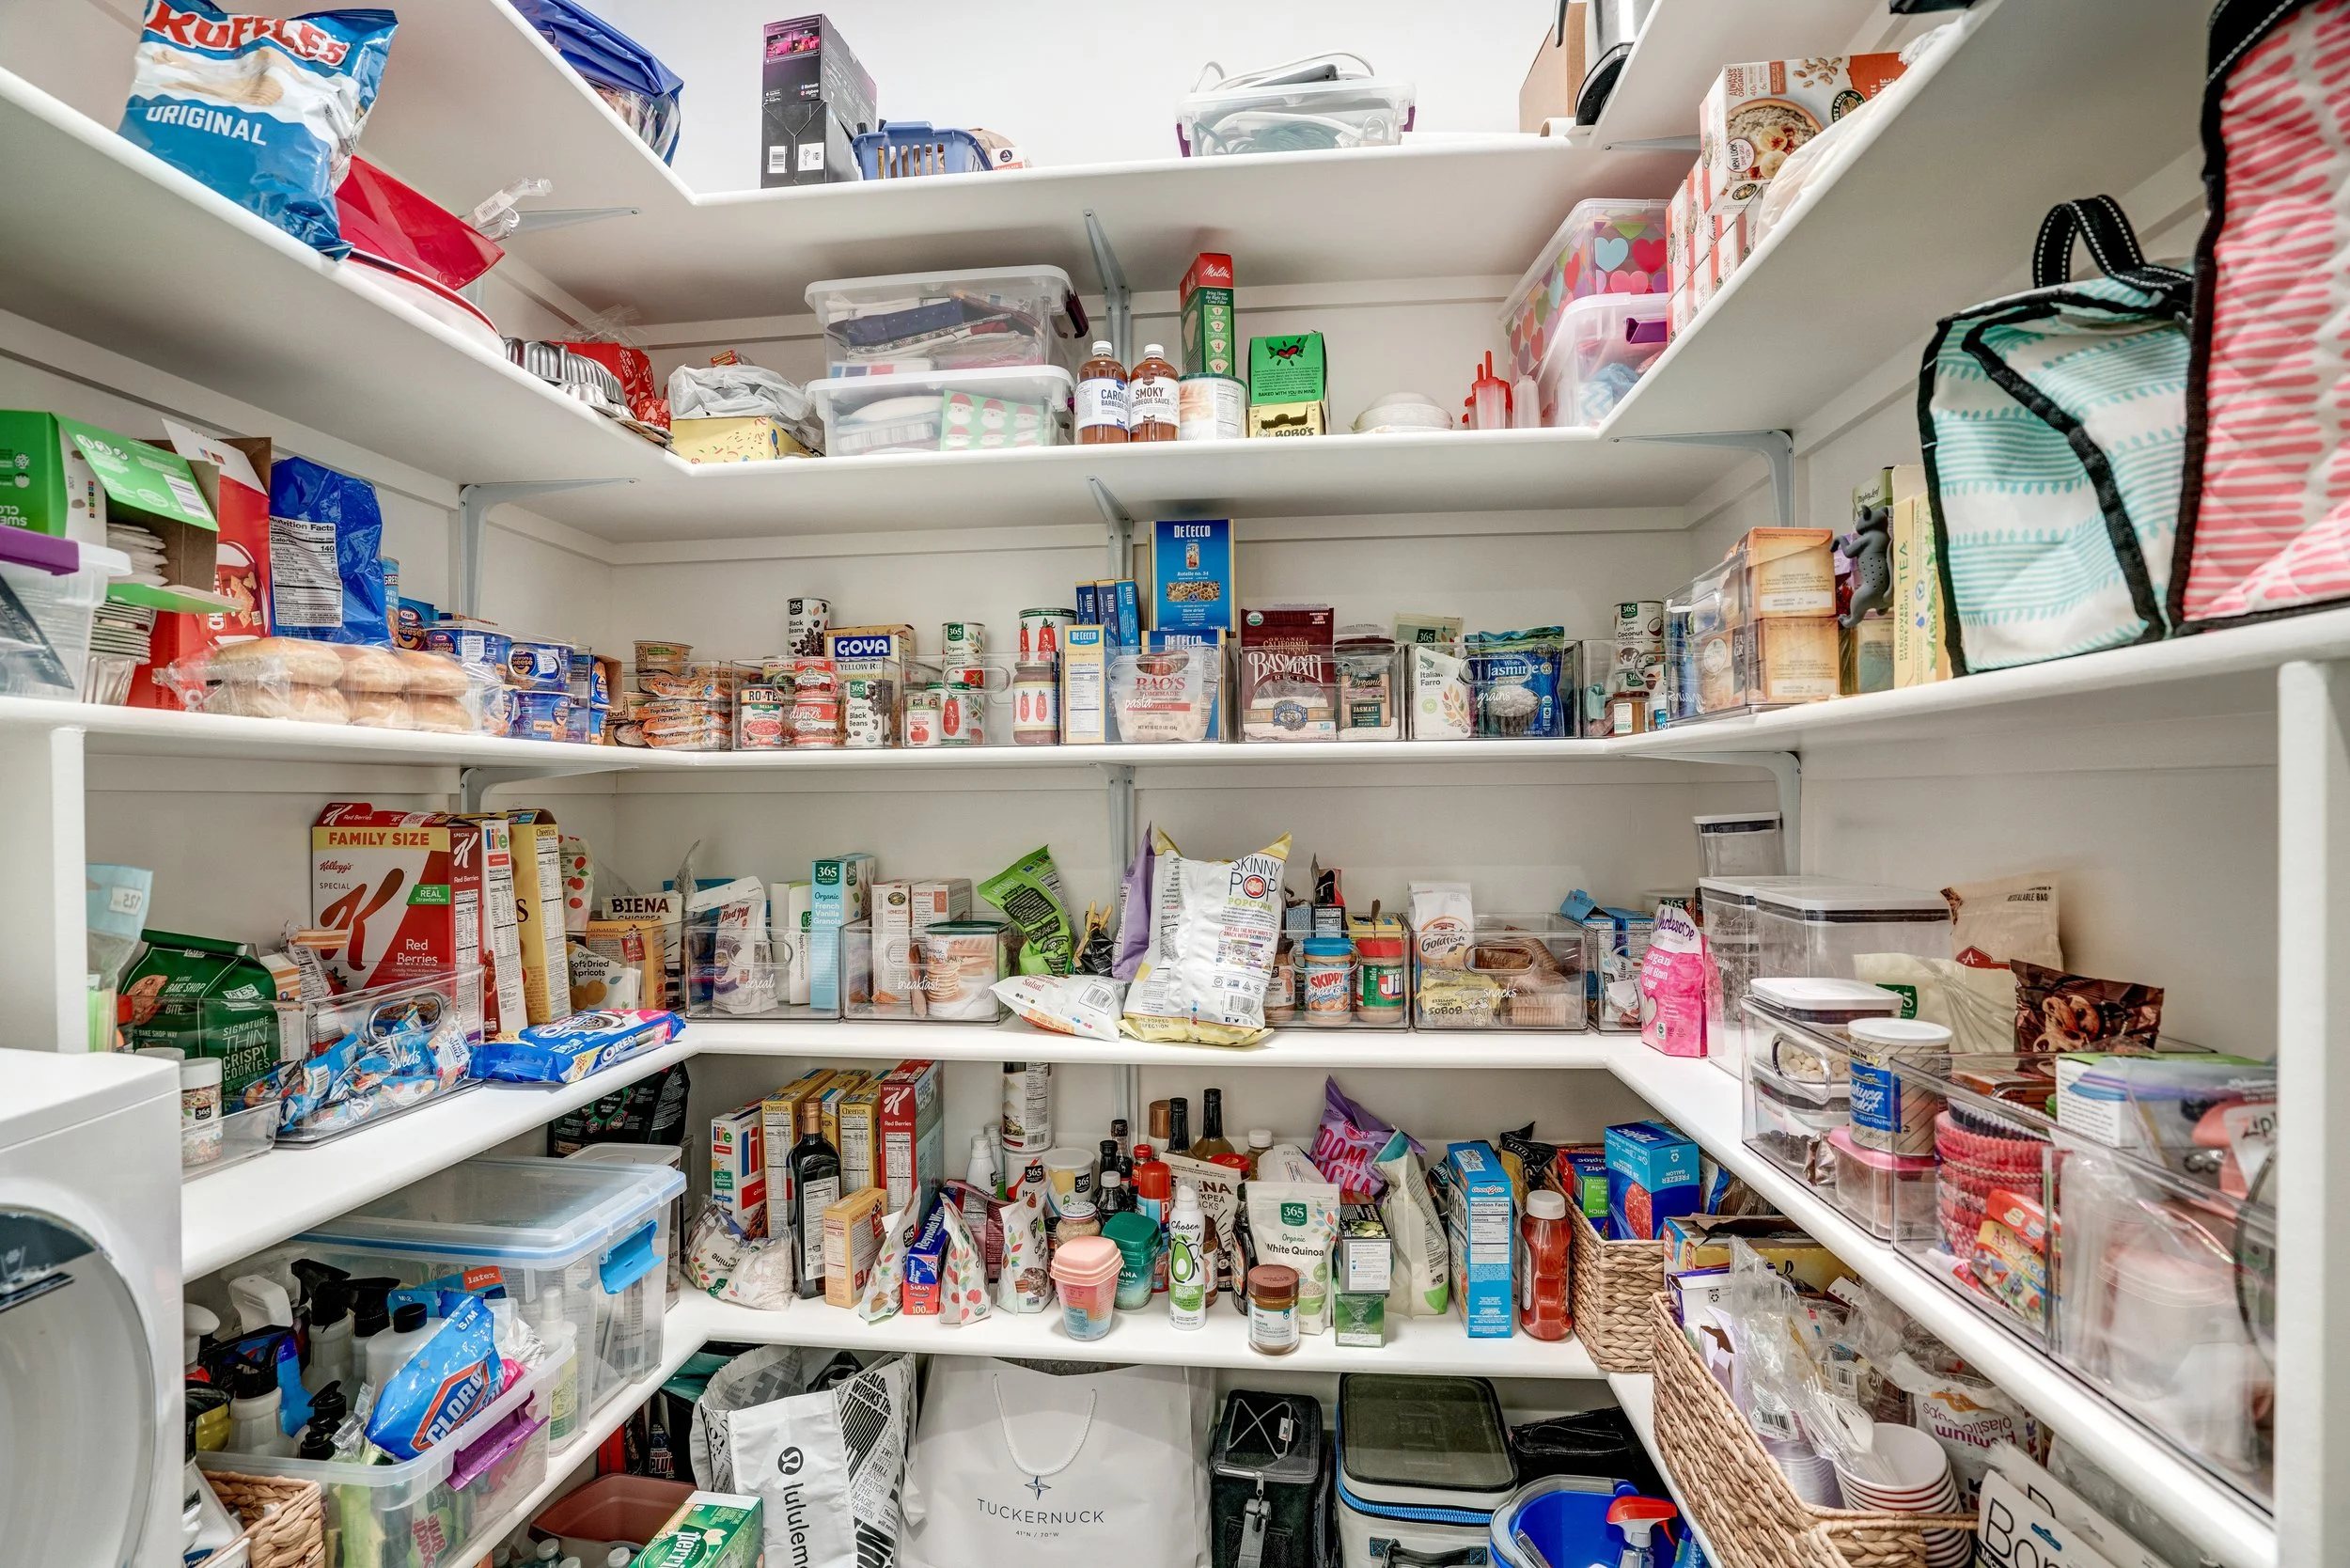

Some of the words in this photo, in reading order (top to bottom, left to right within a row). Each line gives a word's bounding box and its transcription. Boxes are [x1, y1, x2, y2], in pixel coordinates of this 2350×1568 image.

[1728, 68, 1738, 97] ALWAYS
[146, 104, 267, 146] ORIGINAL
[1202, 263, 1230, 279] Melitta
[1136, 387, 1164, 400] SMOKY
[1132, 399, 1153, 408] BARBEQUE
[1154, 398, 1171, 406] SAUCE
[1857, 490, 1872, 503] Mighty
[310, 524, 335, 532] Facts
[1185, 525, 1211, 538] CECCO
[1899, 541, 1908, 585] TEA
[790, 602, 801, 610] 365
[1622, 604, 1637, 613] 365
[401, 610, 416, 620] Kraft
[948, 627, 963, 636] 365
[1080, 631, 1096, 640] CECCO
[1418, 632, 1434, 643] 365
[837, 638, 888, 656] GOYA
[839, 662, 868, 671] YELLOW
[1248, 652, 1324, 686] BASMATI
[1487, 664, 1539, 677] Jasmine
[852, 683, 864, 693] 365
[1136, 677, 1186, 691] RAO'S
[1125, 694, 1153, 713] pasta
[1477, 691, 1512, 708] grains
[790, 705, 822, 722] dinner
[329, 832, 386, 846] FAMILY
[392, 832, 430, 846] SIZE
[486, 828, 509, 851] life
[536, 828, 556, 838] Cheerios
[320, 860, 352, 873] Kellogg's
[818, 866, 838, 878] 365
[1231, 855, 1280, 875] SKINNY
[420, 889, 442, 898] REAL
[1229, 871, 1277, 902] POP
[814, 892, 839, 902] Organic
[2036, 892, 2049, 902] BAG
[611, 898, 669, 914] BIENA
[1227, 897, 1274, 913] POPCORN
[320, 868, 405, 971] K
[405, 939, 429, 950] Red
[1249, 934, 1272, 943] SKINNYPOP
[1421, 935, 1466, 952] Goldfish
[397, 952, 438, 966] Berries
[588, 960, 610, 968] Dried
[572, 969, 606, 979] Apricots
[744, 973, 776, 989] cereal
[1309, 972, 1344, 989] SKIPPY
[165, 982, 184, 994] BAKE
[186, 982, 207, 994] SHOP
[897, 975, 941, 991] breakfast
[1022, 979, 1045, 992] Salsa!
[1482, 982, 1517, 998] snacks
[225, 984, 256, 998] TATE'S
[164, 1004, 185, 1016] BITE.
[223, 1015, 269, 1037] SIGNATURE
[222, 1027, 268, 1055] THIN
[600, 1035, 634, 1062] OREO
[223, 1044, 268, 1071] CRISPY
[389, 1047, 421, 1073] sweets
[224, 1058, 271, 1081] COOKIES
[917, 1081, 931, 1099] FREE
[764, 1104, 789, 1113] Cheerios
[884, 1088, 911, 1116] K
[196, 1108, 212, 1117] 365
[841, 1106, 866, 1116] Cheerios
[713, 1126, 732, 1143] life
[1026, 1168, 1042, 1178] 365
[1612, 1160, 1633, 1176] FREEZER
[1076, 1177, 1089, 1188] 365
[1661, 1174, 1690, 1184] FREEZER
[1284, 1206, 1304, 1218] 365
[1171, 1220, 1200, 1231] Chosen
[903, 1226, 915, 1240] 365
[917, 1219, 940, 1250] Reynolds
[1281, 1233, 1307, 1244] Organic
[1265, 1242, 1290, 1254] White
[1292, 1247, 1324, 1257] Quinoa
[467, 1271, 495, 1284] latex
[910, 1283, 931, 1292] SARAN
[912, 1305, 927, 1314] 100
[459, 1310, 478, 1331] S/M
[852, 1379, 884, 1407] WORKS
[1922, 1403, 1959, 1425] cups
[1963, 1414, 2013, 1433] plastic
[881, 1447, 894, 1459] TRY
[876, 1454, 893, 1469] WITH
[866, 1470, 883, 1482] AND
[870, 1461, 887, 1477] WILL
[858, 1484, 873, 1497] THE
[862, 1476, 886, 1496] WATCH
[853, 1493, 876, 1510] MAGIC
[977, 1497, 1104, 1525] TUCKERNUCK
